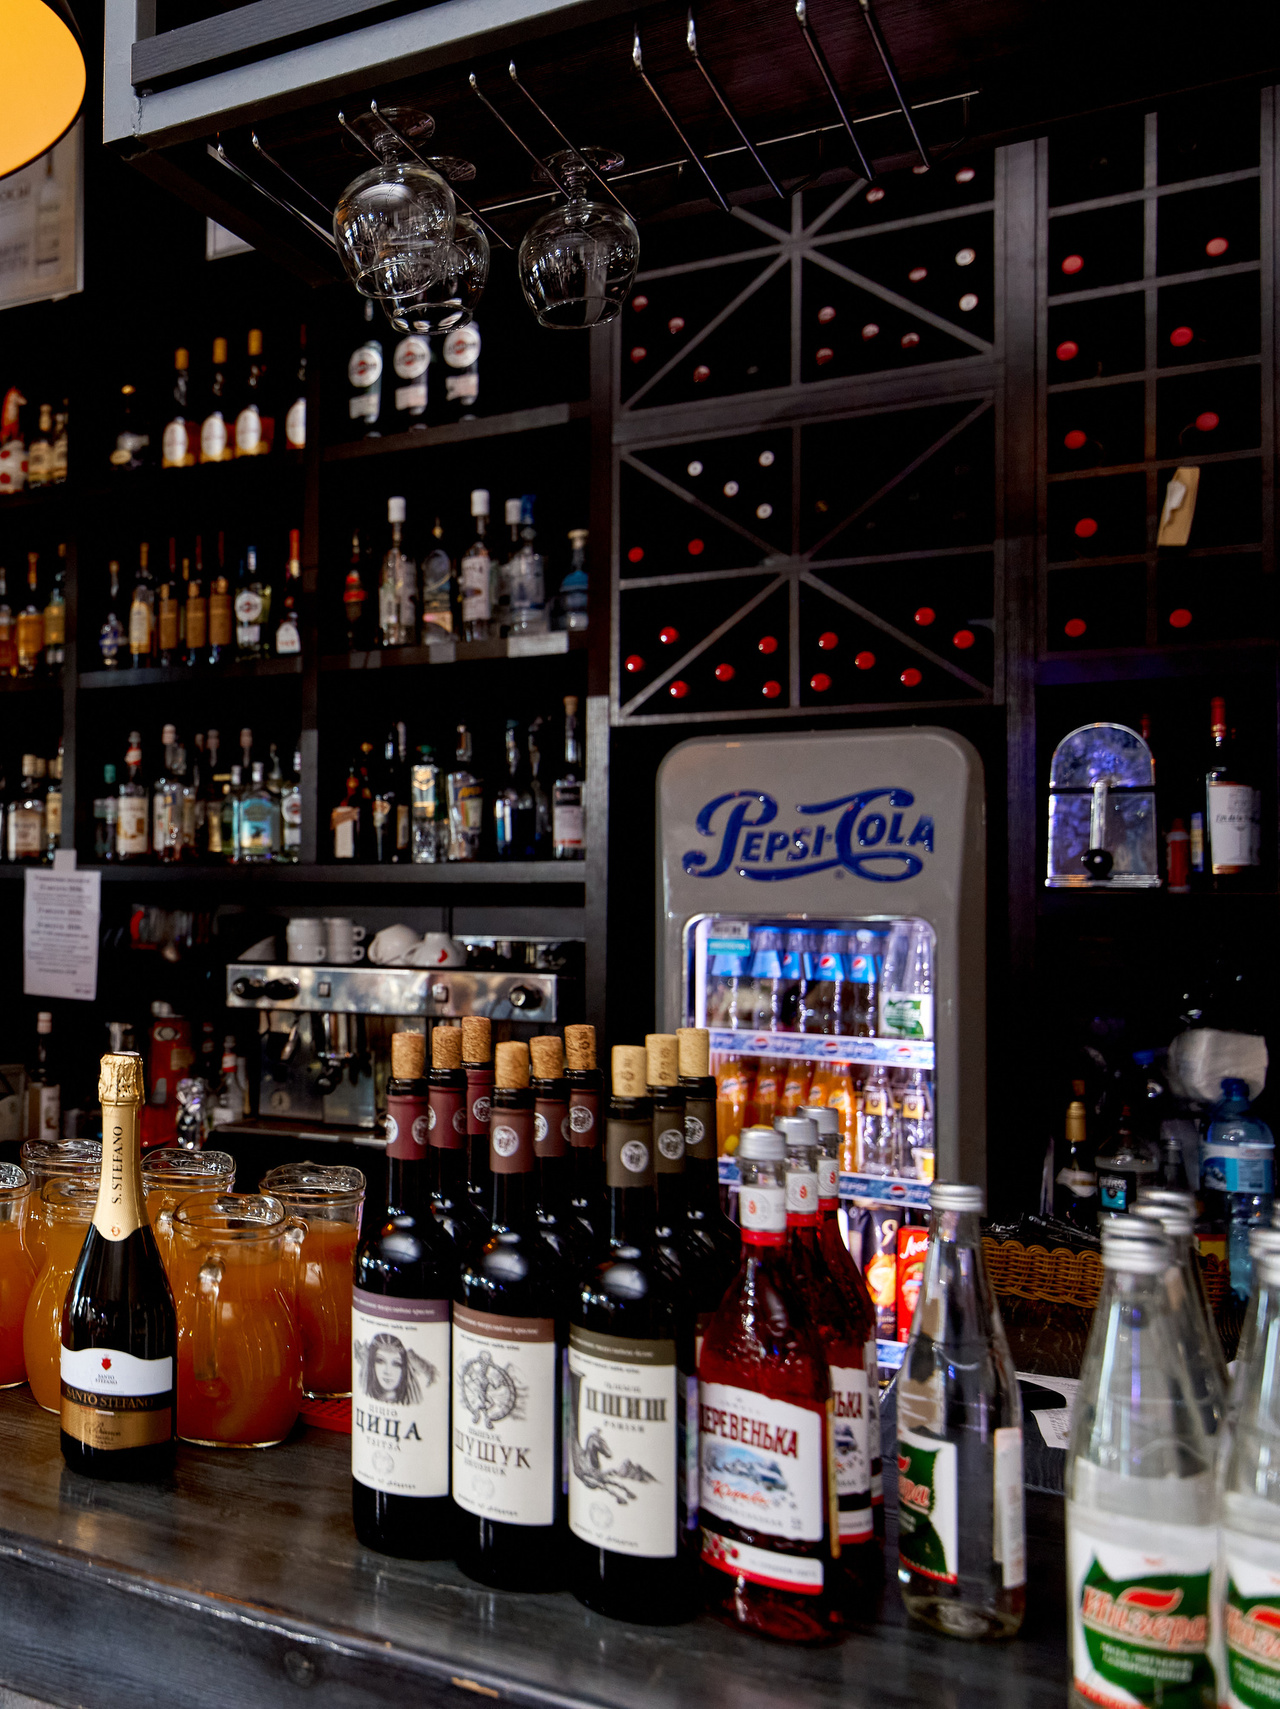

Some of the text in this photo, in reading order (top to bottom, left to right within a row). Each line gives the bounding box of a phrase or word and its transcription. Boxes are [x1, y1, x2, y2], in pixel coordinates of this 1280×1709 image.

[66, 1387, 98, 1406] SANTO
[585, 1387, 667, 1422] ПШИШ
[355, 1407, 423, 1442] ЦИЦА
[699, 1403, 799, 1459] ДЕРЕВЕНЬКА
[455, 1428, 532, 1469] ШУШУК
